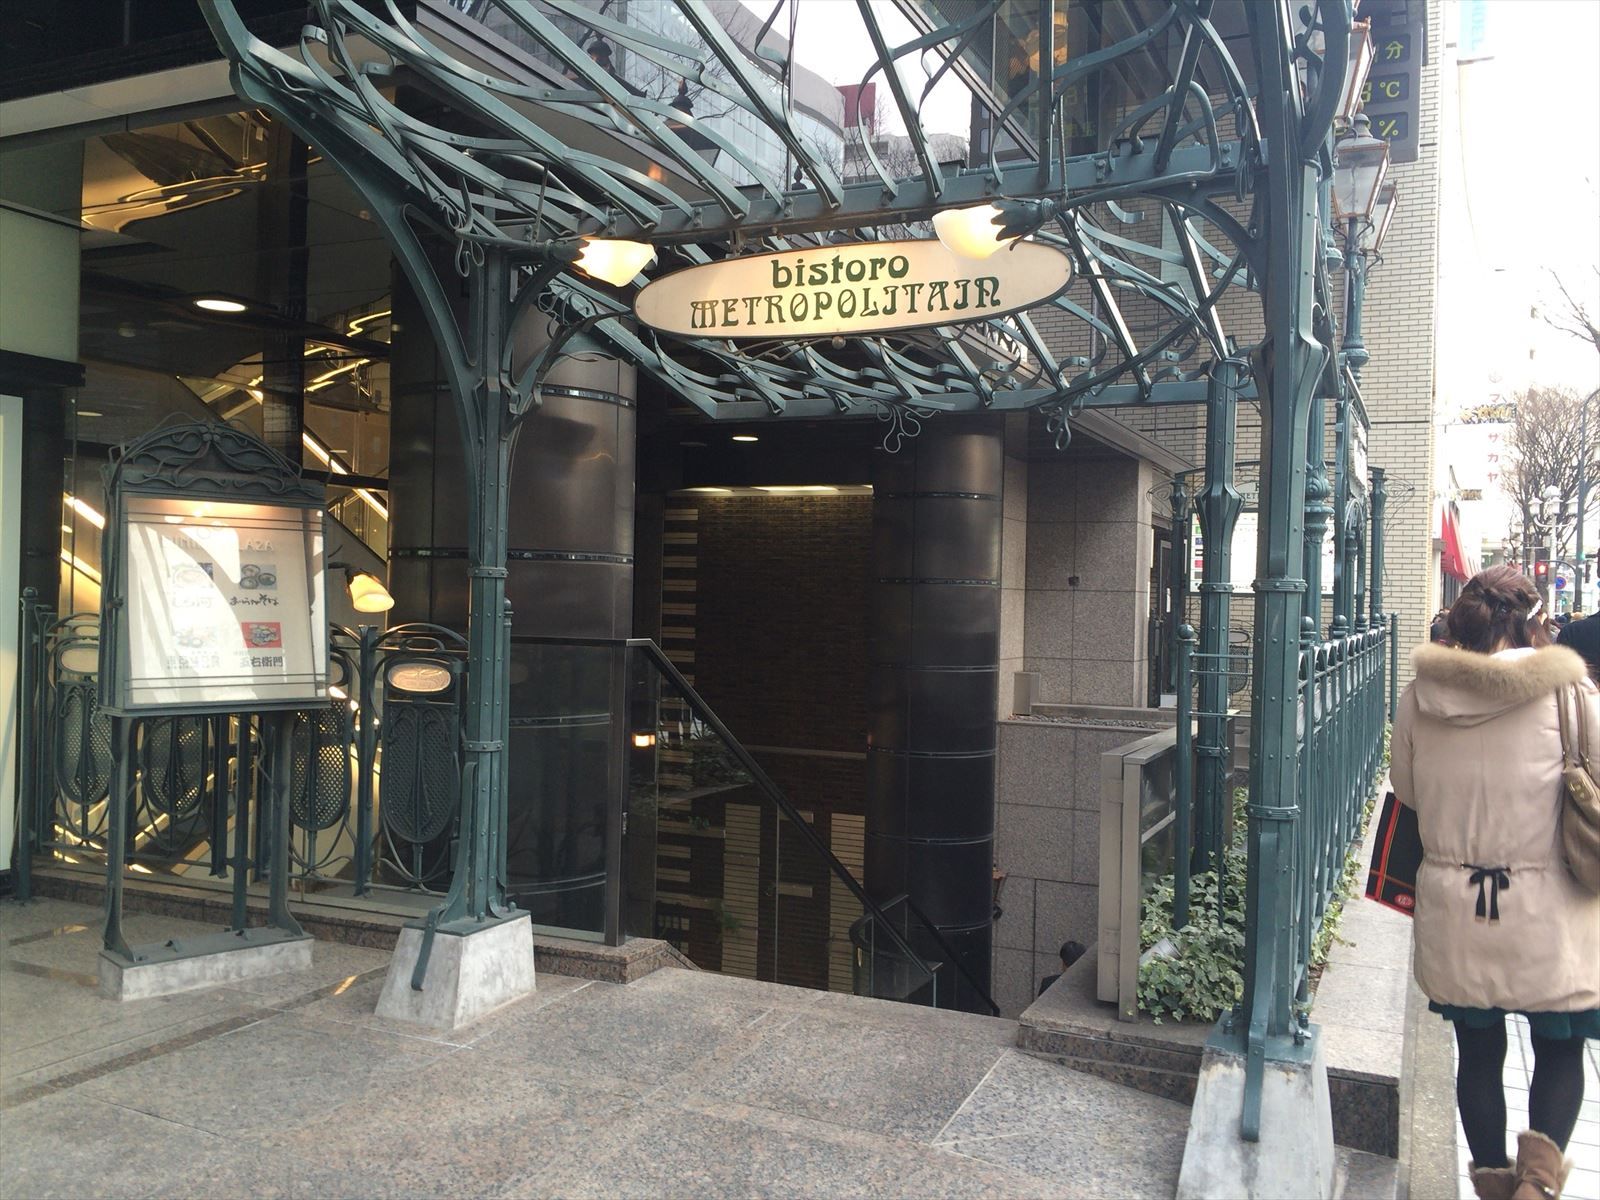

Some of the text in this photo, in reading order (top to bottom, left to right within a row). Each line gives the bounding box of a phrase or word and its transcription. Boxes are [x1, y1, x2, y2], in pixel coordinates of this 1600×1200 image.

[1385, 41, 1404, 60] 分
[1379, 119, 1399, 137] %
[771, 255, 910, 289] bistoro
[690, 276, 1001, 329] METROPOLITAIN
